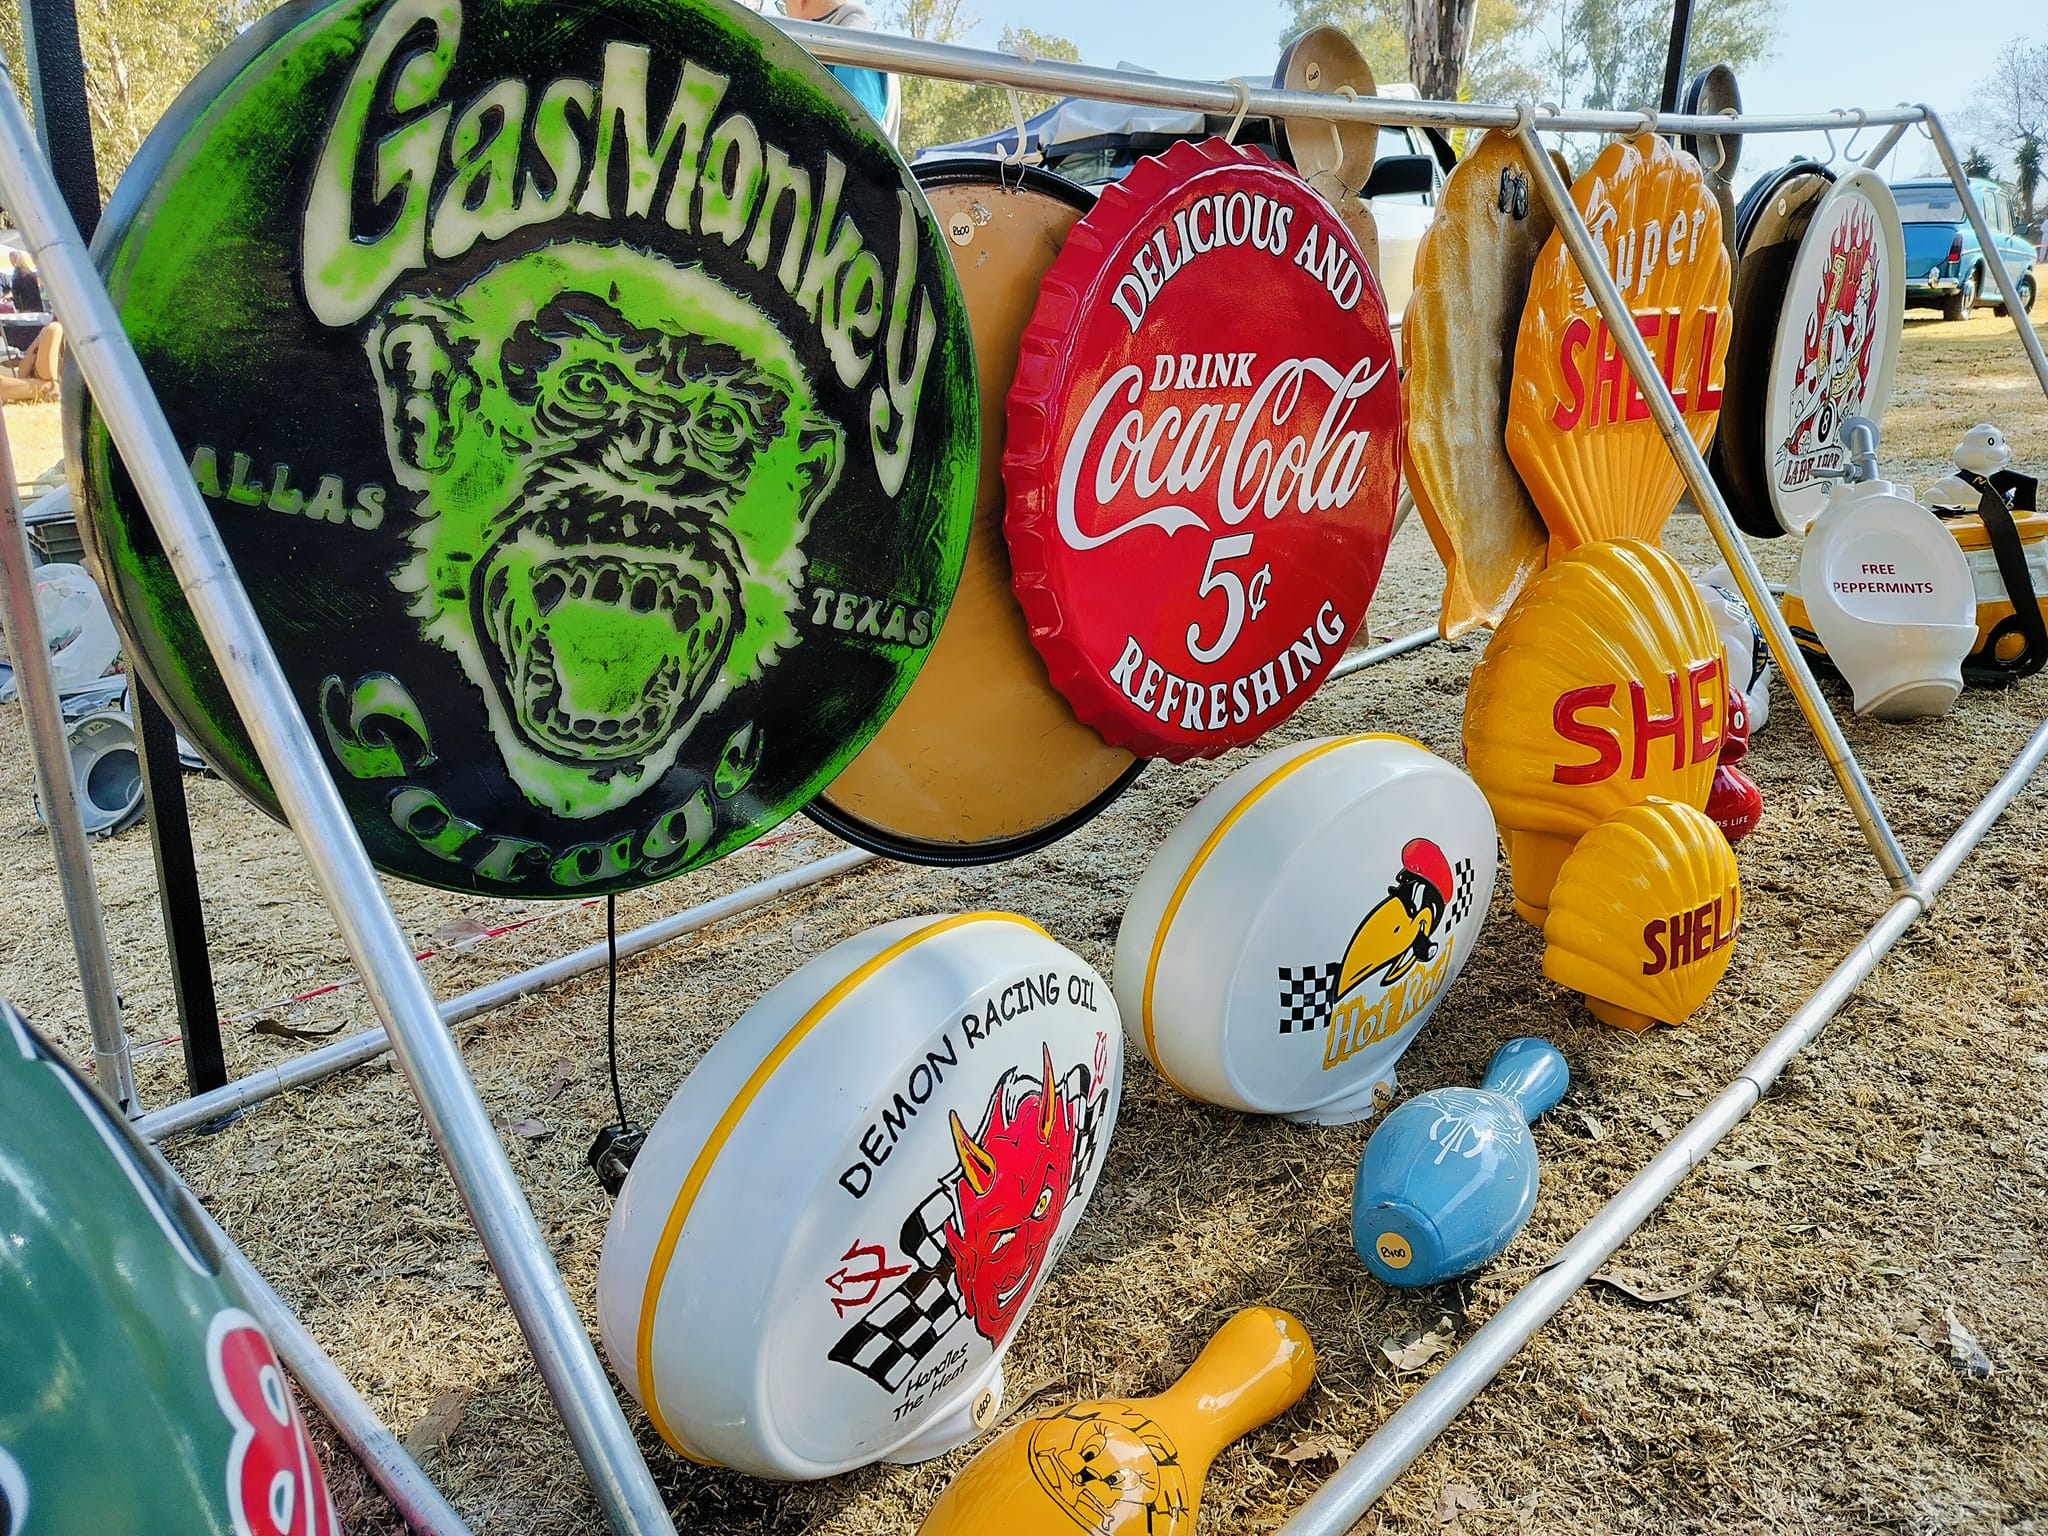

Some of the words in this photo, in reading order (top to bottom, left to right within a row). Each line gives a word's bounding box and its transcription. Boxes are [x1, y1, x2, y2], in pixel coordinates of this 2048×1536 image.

[1111, 190, 1294, 334] DELICIOUS
[1294, 223, 1364, 311] AND
[1149, 353, 1257, 392] DRINK
[1551, 311, 1722, 433] SHELL
[188, 446, 387, 531] ALLAS
[1056, 356, 1392, 551] Coca-Cola
[1833, 582, 1934, 594] PEPPERMINTS
[1861, 564, 1896, 575] FREE
[810, 587, 933, 648] TEXAS
[1108, 599, 1346, 731] REFRESHING
[319, 671, 765, 887] Garage
[1731, 815, 1749, 826] LIFE
[1642, 885, 1740, 976] SHELL
[1326, 995, 1394, 1064] Hot
[1397, 941, 1452, 1025] Rod
[839, 1034, 958, 1199] DEMON
[961, 972, 1060, 1050] RACING
[1067, 975, 1097, 1012] OIL
[893, 1394, 925, 1422] The
[929, 1358, 968, 1398] Heat
[905, 1342, 969, 1398] Handles
